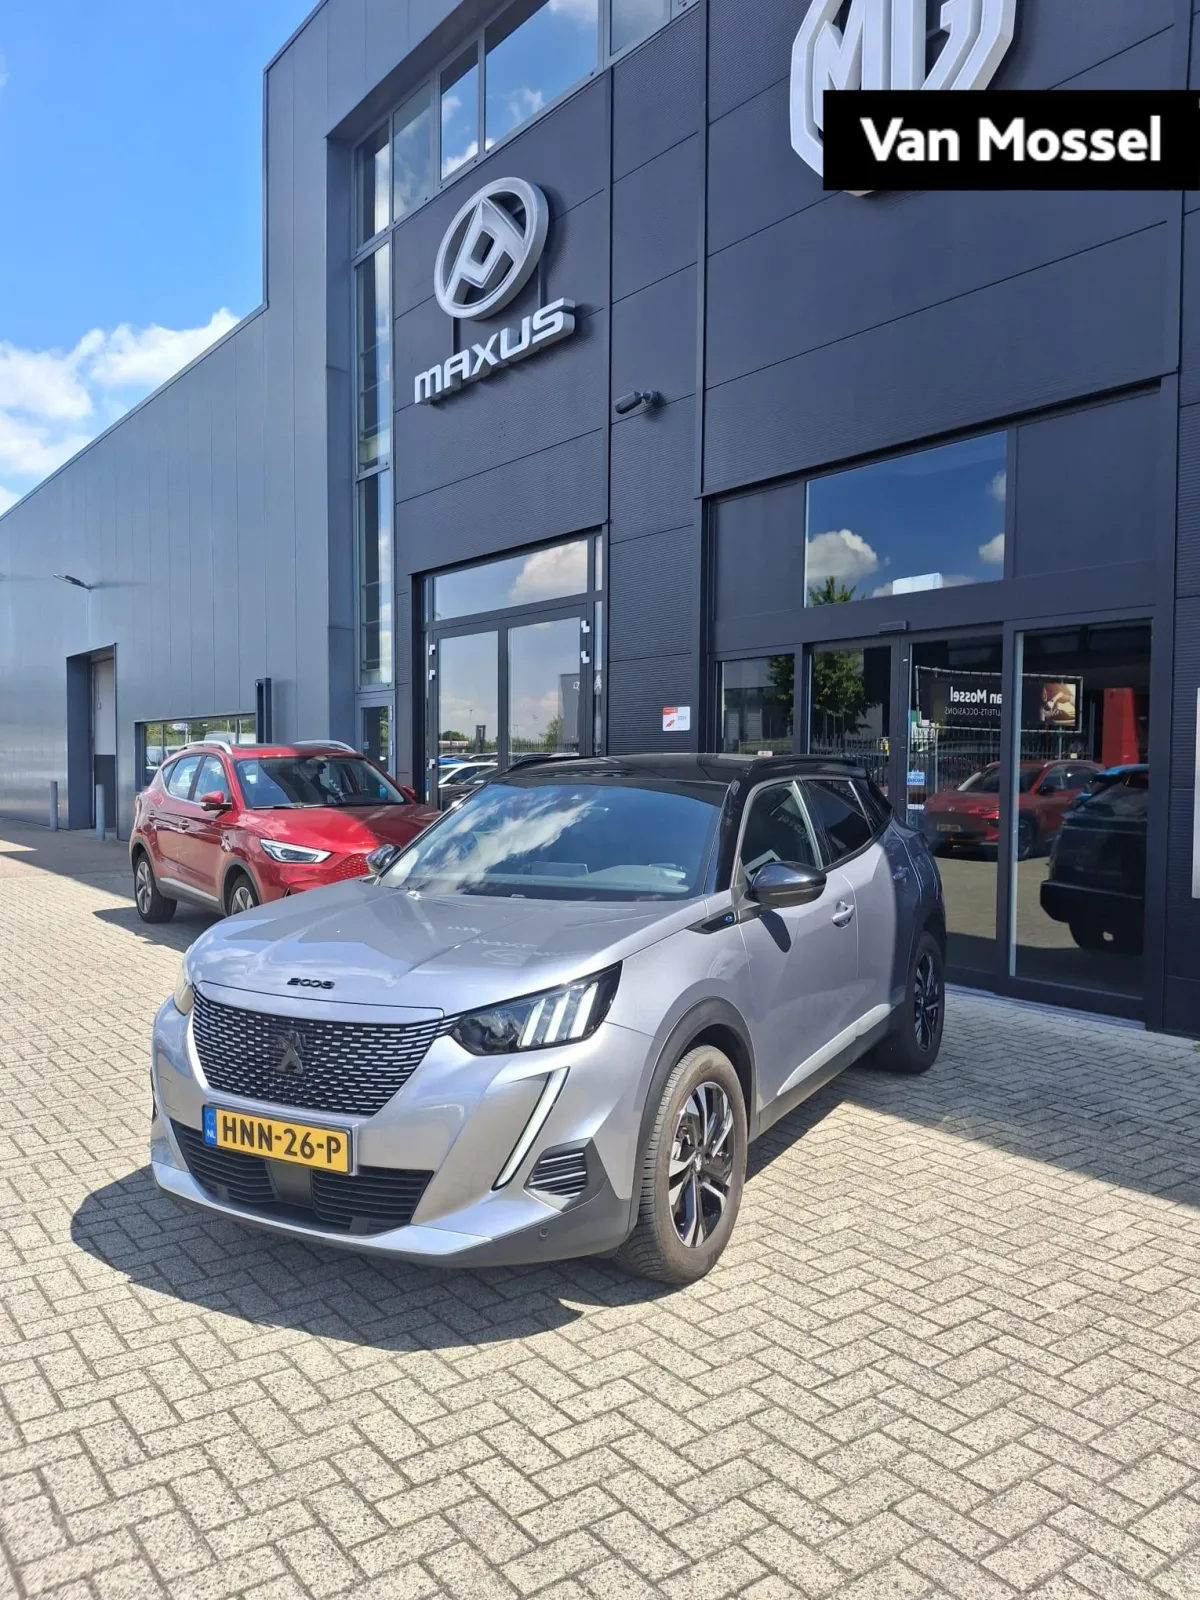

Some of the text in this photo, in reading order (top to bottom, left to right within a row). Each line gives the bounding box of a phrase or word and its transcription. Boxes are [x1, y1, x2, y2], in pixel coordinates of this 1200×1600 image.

[414, 298, 576, 404] MAXUS
[287, 977, 335, 990] 2008
[222, 1115, 342, 1163] HNN-26-P
